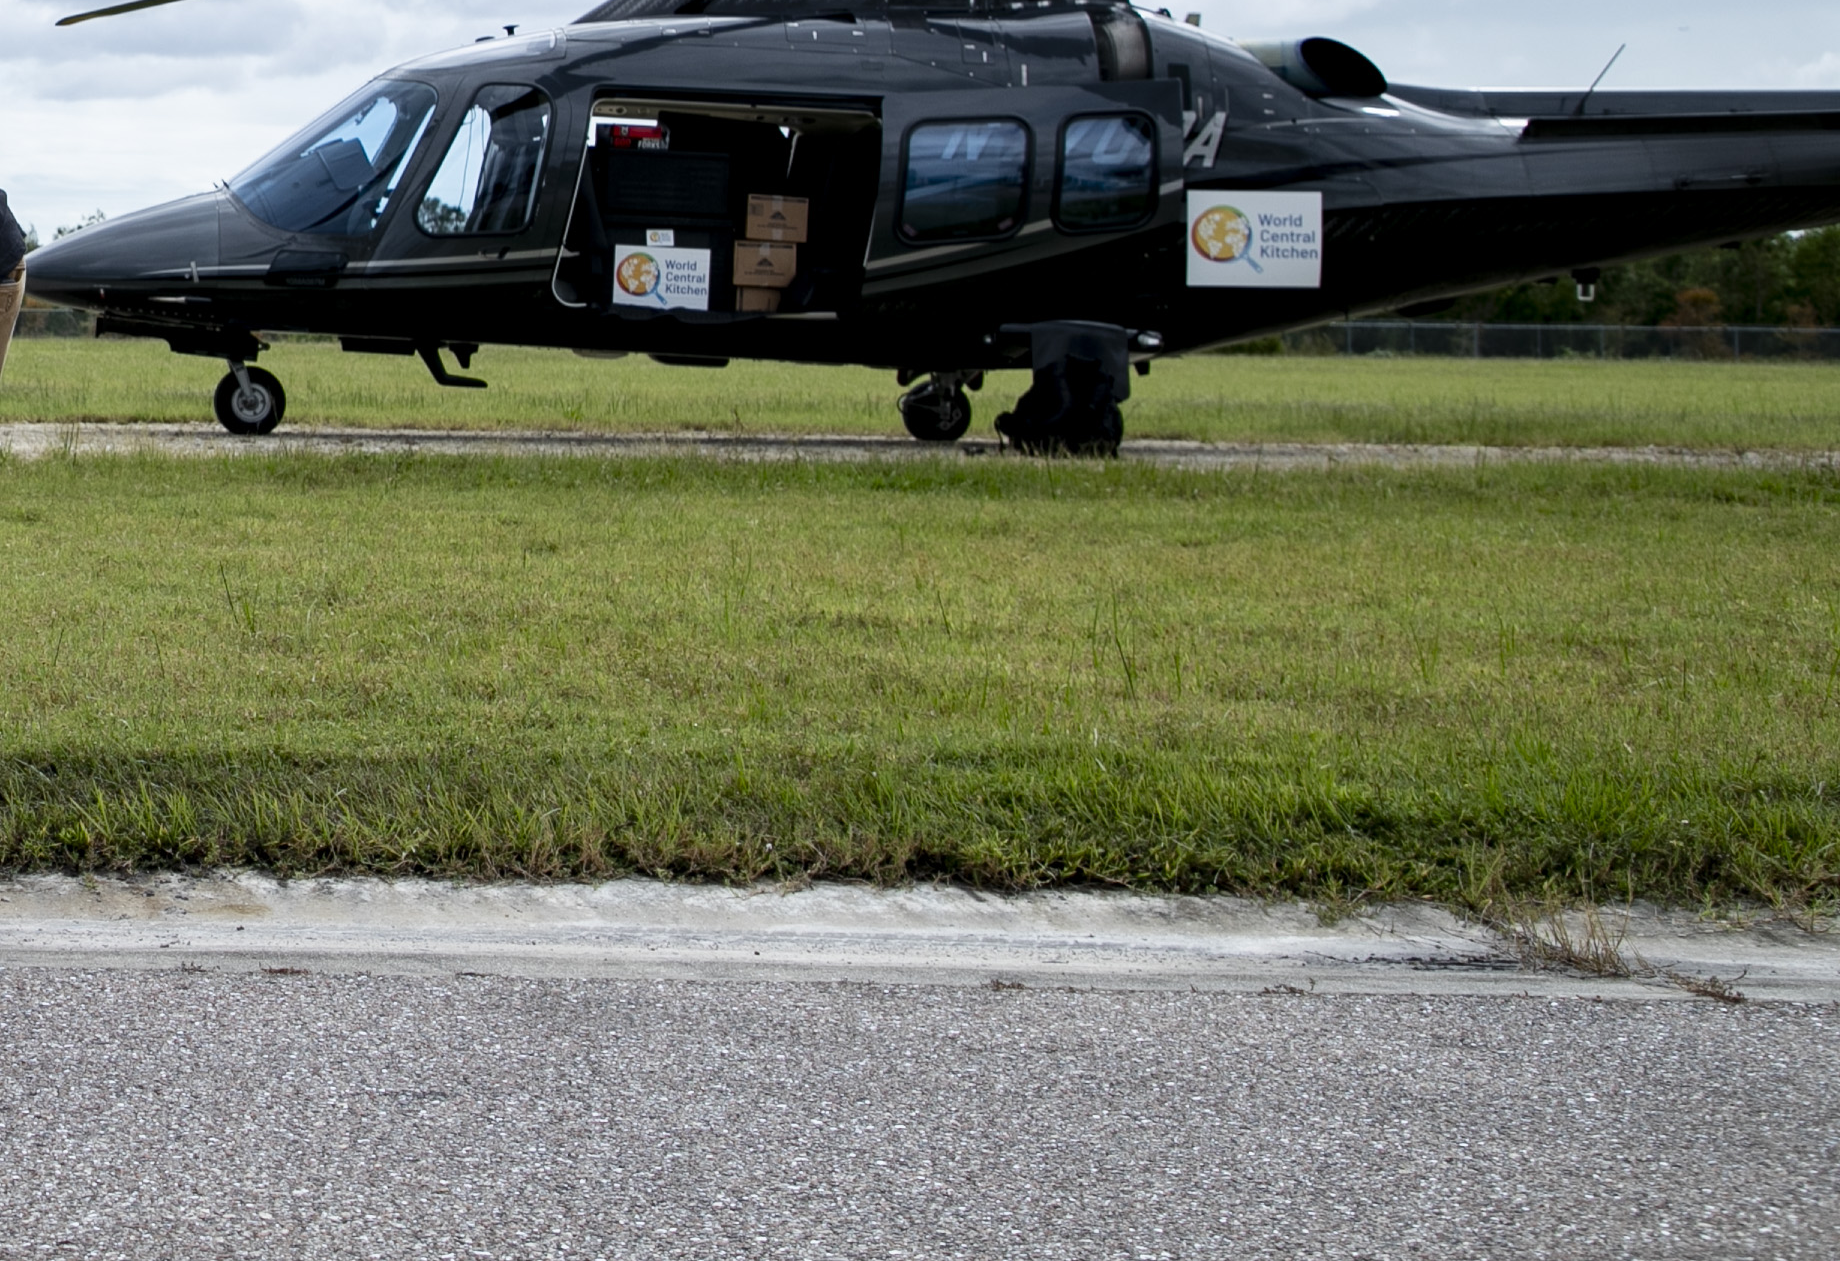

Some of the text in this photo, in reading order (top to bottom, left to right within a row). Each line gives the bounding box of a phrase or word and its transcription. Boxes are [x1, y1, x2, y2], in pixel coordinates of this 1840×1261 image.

[1258, 213, 1303, 228] World
[1260, 228, 1316, 244] Central
[1260, 245, 1319, 259] Kitchen
[665, 259, 697, 271] World
[665, 271, 706, 284] Central
[665, 283, 708, 295] Kitchen
